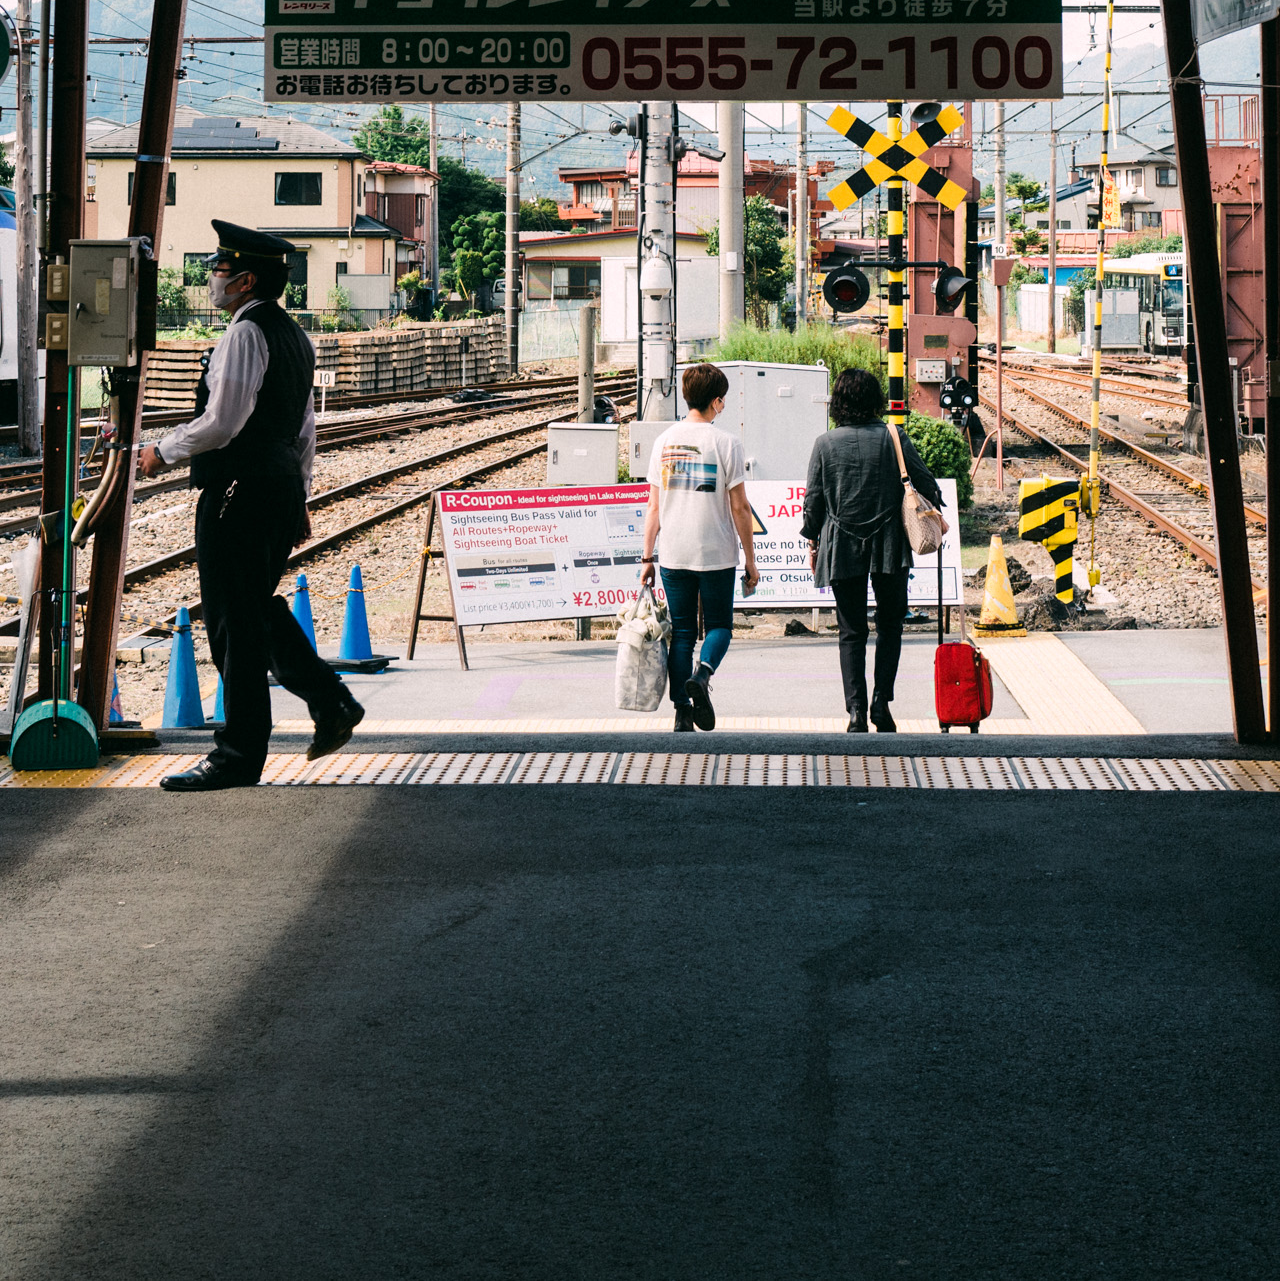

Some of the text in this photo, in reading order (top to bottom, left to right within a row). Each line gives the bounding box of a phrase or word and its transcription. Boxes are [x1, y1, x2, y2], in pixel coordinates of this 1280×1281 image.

[283, 2, 331, 11] レンタリース
[279, 37, 361, 66] 営業時間
[581, 35, 1054, 91] 0555-72-1100
[275, 73, 572, 97] お電話お待ちしております。
[994, 244, 1006, 255] 10
[318, 372, 332, 387] 10
[446, 494, 513, 509] R-Coupon
[517, 495, 535, 504] Ideal
[536, 494, 547, 503] for
[548, 493, 589, 504] sightseeing
[589, 492, 597, 500] in
[597, 491, 615, 500] Lake
[450, 514, 509, 526] Sightseeing
[511, 513, 531, 522] Bus
[532, 510, 557, 521] Pass
[558, 508, 582, 519] Valid
[583, 508, 598, 518] for
[453, 523, 558, 536] All Routes+Ropeway+
[454, 533, 569, 550] Sightseeing Boat Ticket
[780, 541, 795, 550] no
[578, 550, 606, 558] Ropeway
[754, 553, 807, 565] lease pay
[463, 598, 554, 613] List price ¥3,400(¥1,700)
[572, 589, 625, 608] ¥2,800
